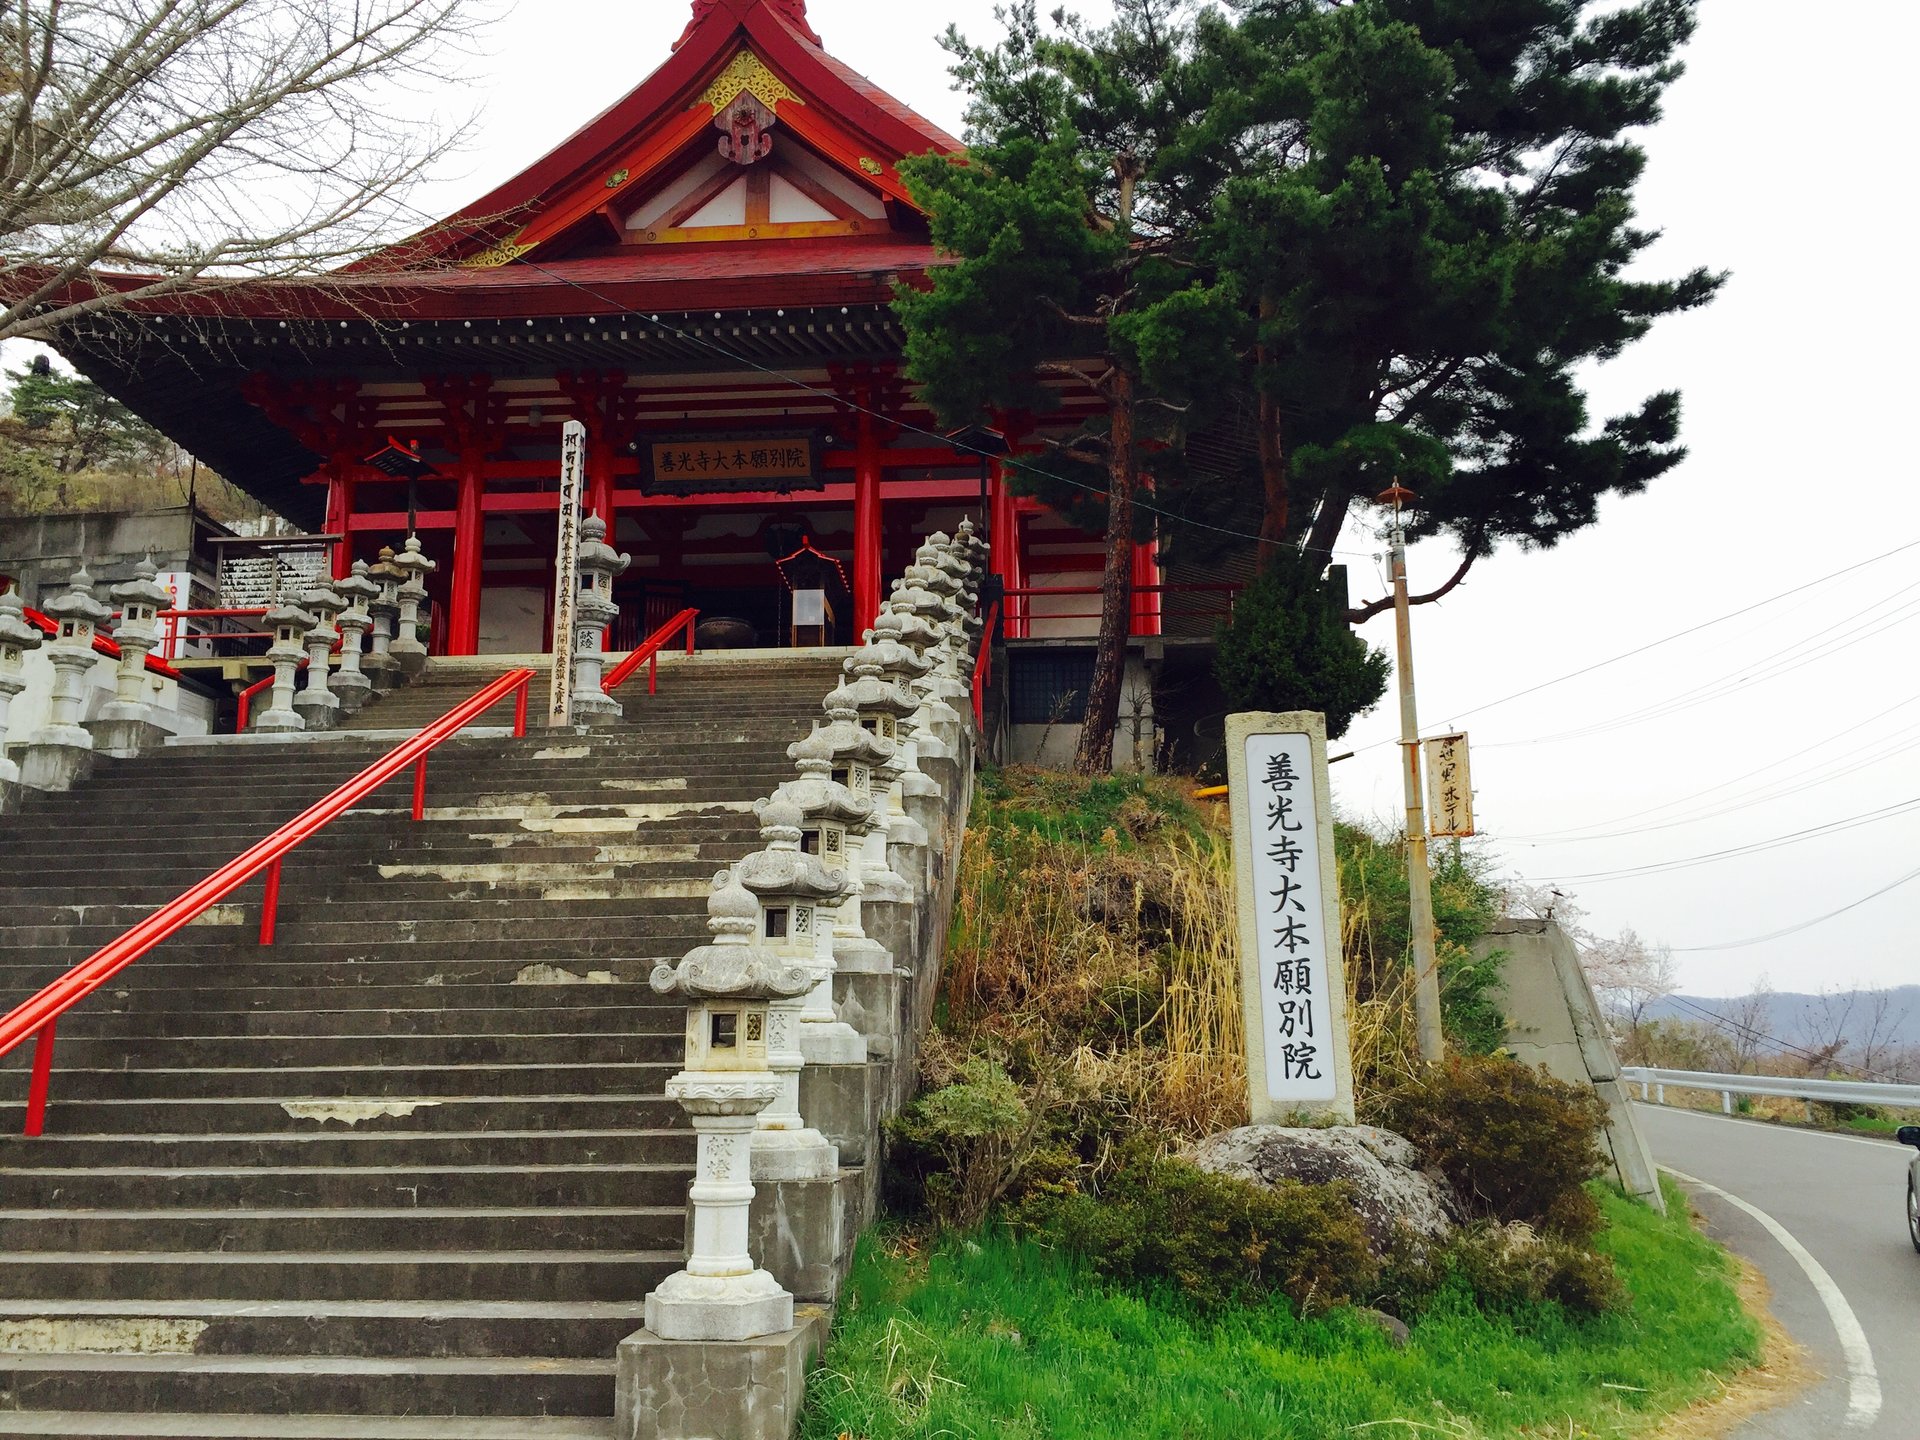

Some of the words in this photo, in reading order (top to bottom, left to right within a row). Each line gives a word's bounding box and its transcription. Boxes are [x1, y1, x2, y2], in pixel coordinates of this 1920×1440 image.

[659, 447, 806, 473] 善光寺大本願別院
[1261, 752, 1322, 1080] 善光寺大本願別院
